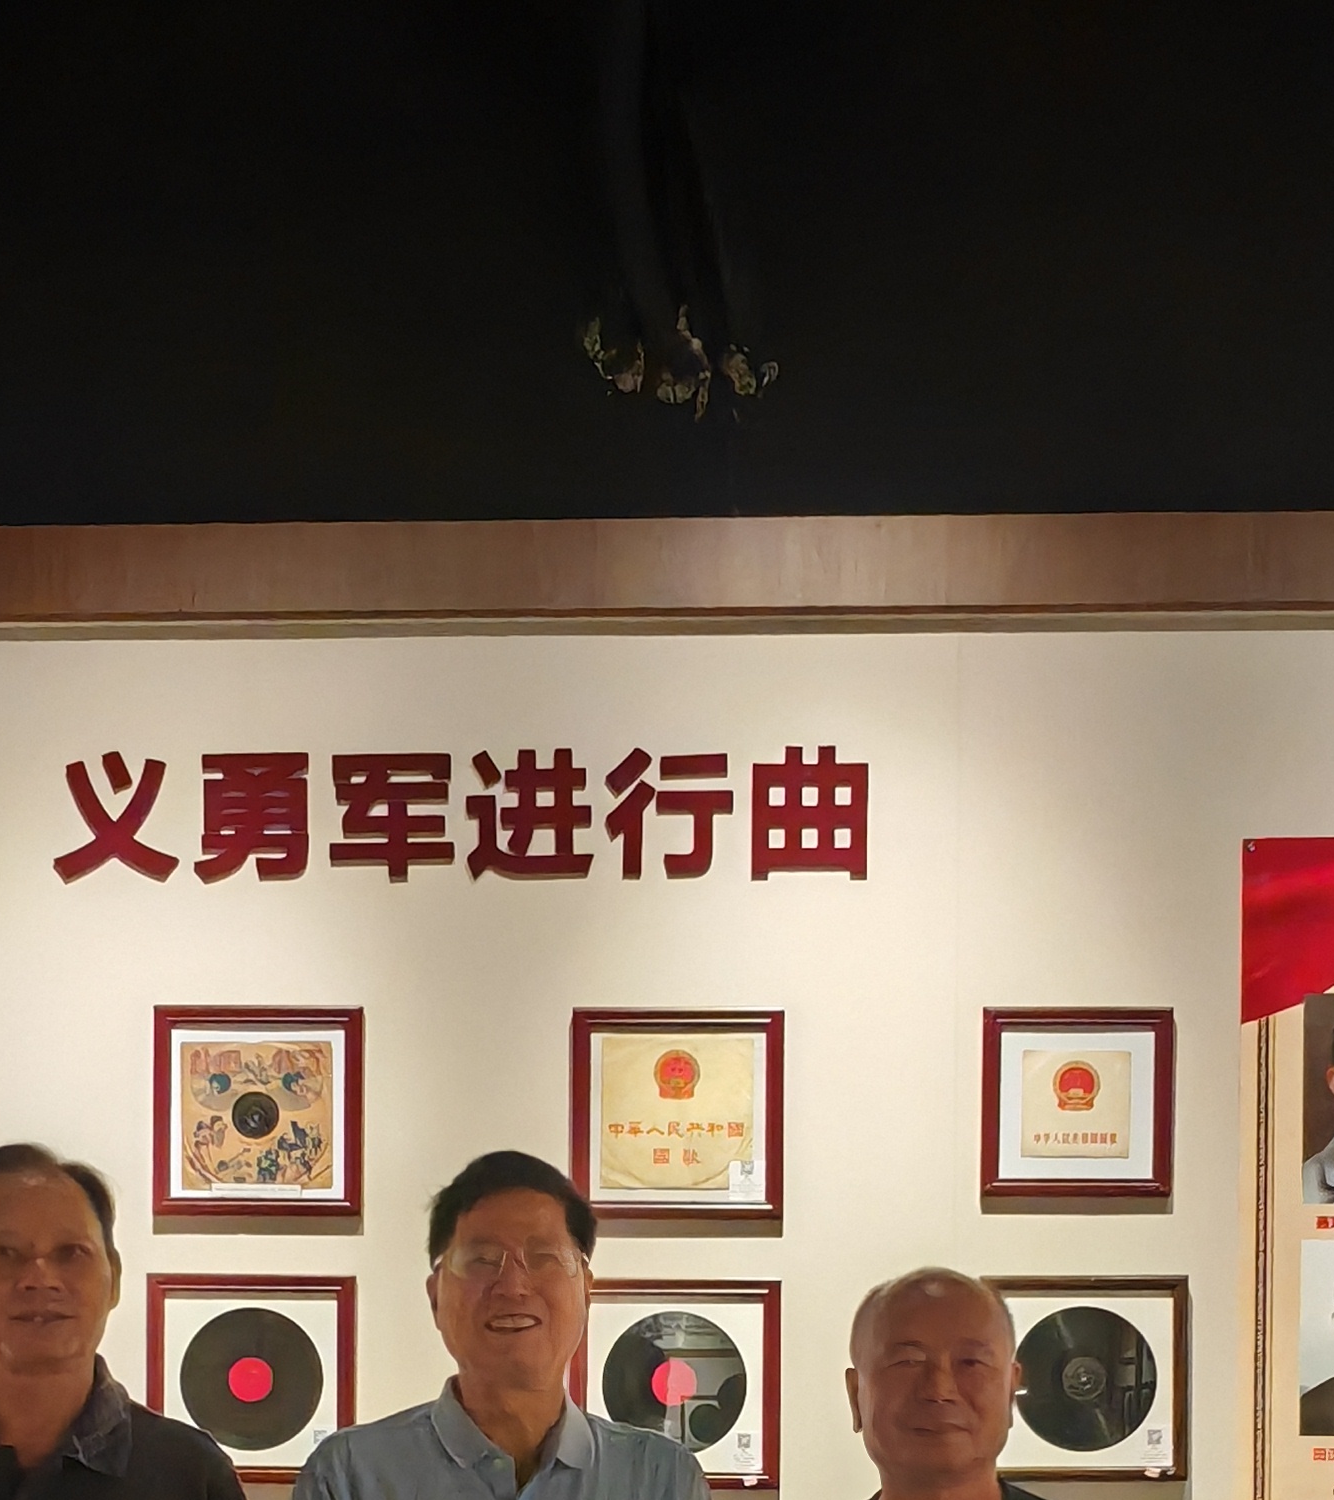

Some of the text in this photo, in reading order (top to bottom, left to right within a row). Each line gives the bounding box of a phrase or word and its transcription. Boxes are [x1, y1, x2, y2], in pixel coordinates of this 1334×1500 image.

[53, 746, 868, 885] 义勇军进行曲
